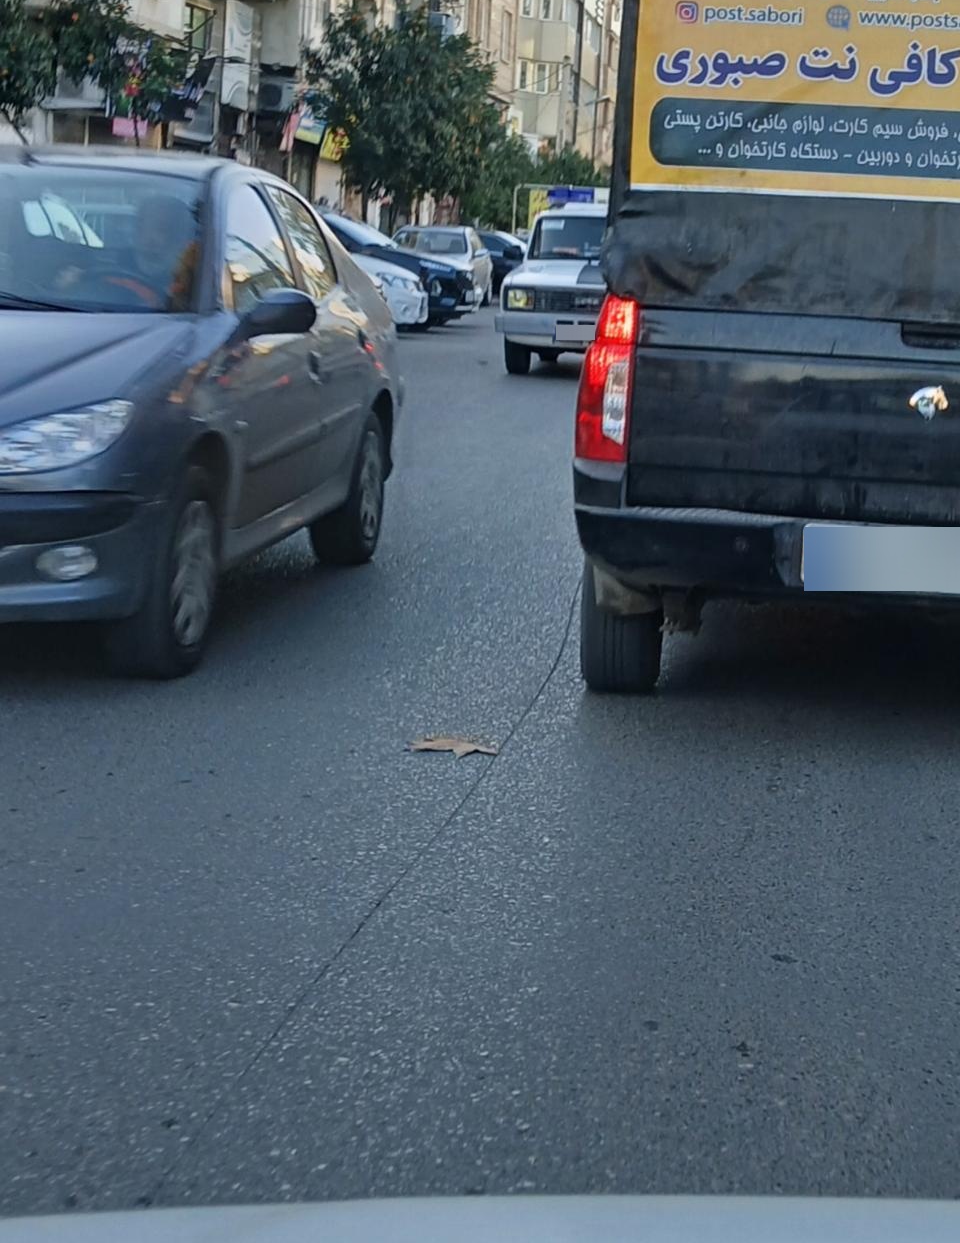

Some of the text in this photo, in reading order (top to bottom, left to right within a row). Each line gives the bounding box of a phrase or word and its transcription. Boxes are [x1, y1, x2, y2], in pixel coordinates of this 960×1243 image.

[704, 6, 802, 23] post.sabori
[656, 49, 787, 87] صبوری
[799, 45, 858, 81] نت
[663, 109, 701, 133] پستی
[705, 111, 744, 131] کارتن
[792, 115, 825, 135] لوازم
[907, 118, 949, 140] فروش
[715, 143, 724, 158] و
[727, 139, 787, 161] کارتخوان
[790, 142, 839, 161] دستگاه
[857, 149, 900, 167] دوربین
[905, 154, 913, 167] و
